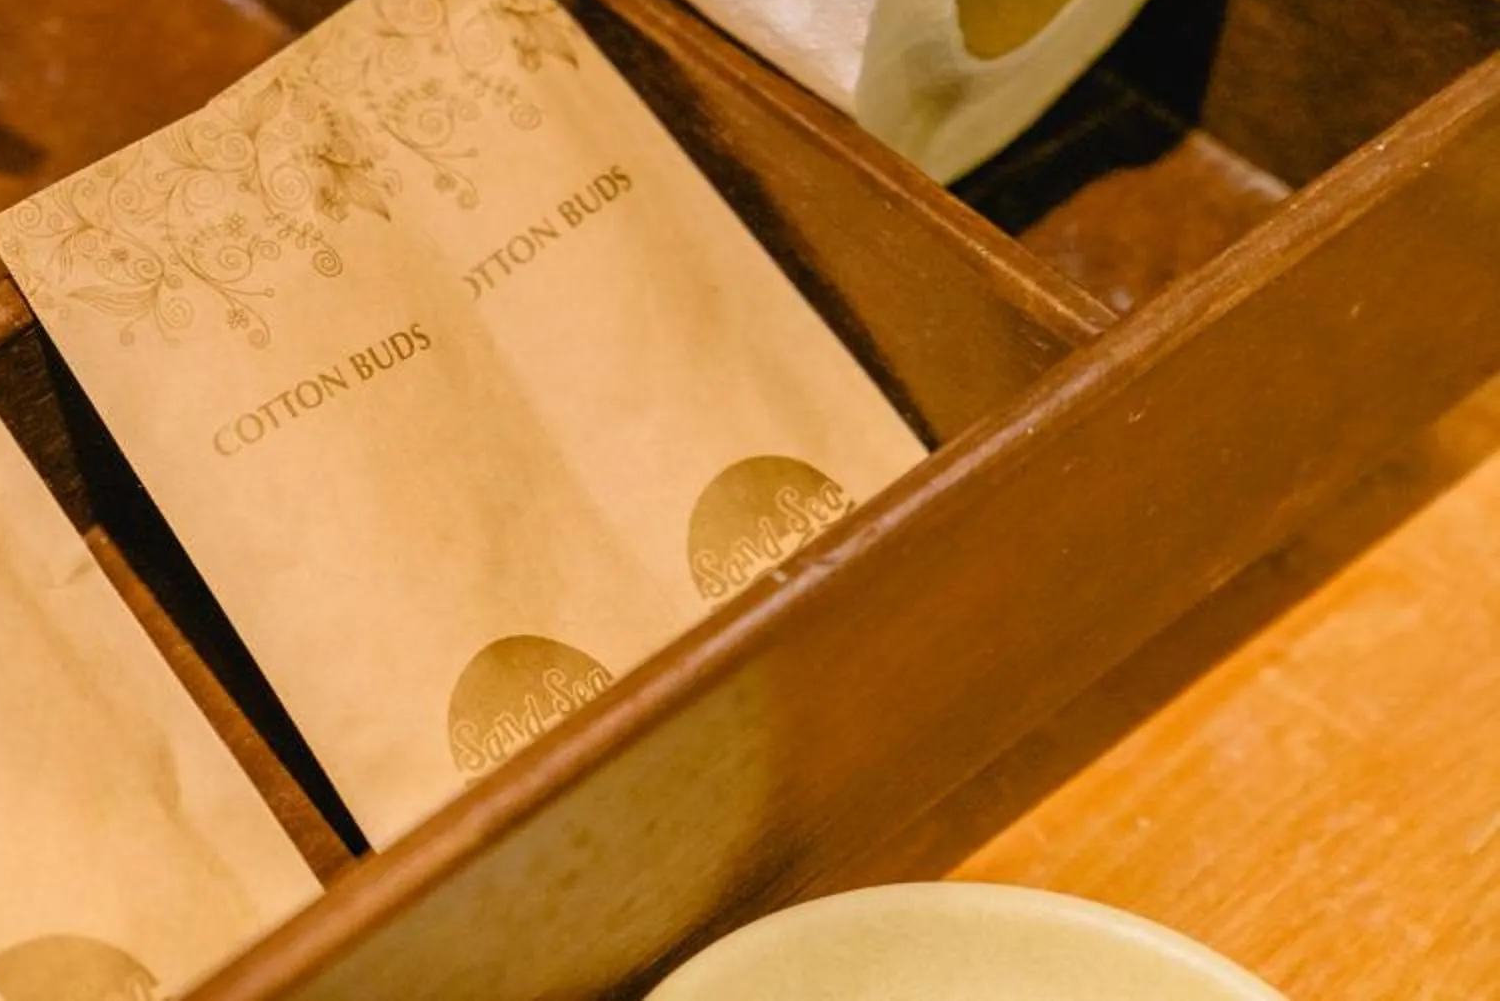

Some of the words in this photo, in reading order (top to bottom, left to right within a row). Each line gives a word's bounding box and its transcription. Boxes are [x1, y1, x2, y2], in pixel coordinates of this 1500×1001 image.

[461, 217, 560, 302] TTON
[556, 164, 633, 230] BUDS
[212, 364, 351, 457] COTTON
[348, 322, 432, 382] BUDS
[694, 515, 784, 599] Sand
[774, 480, 845, 535] Sea
[451, 693, 550, 773] Sand
